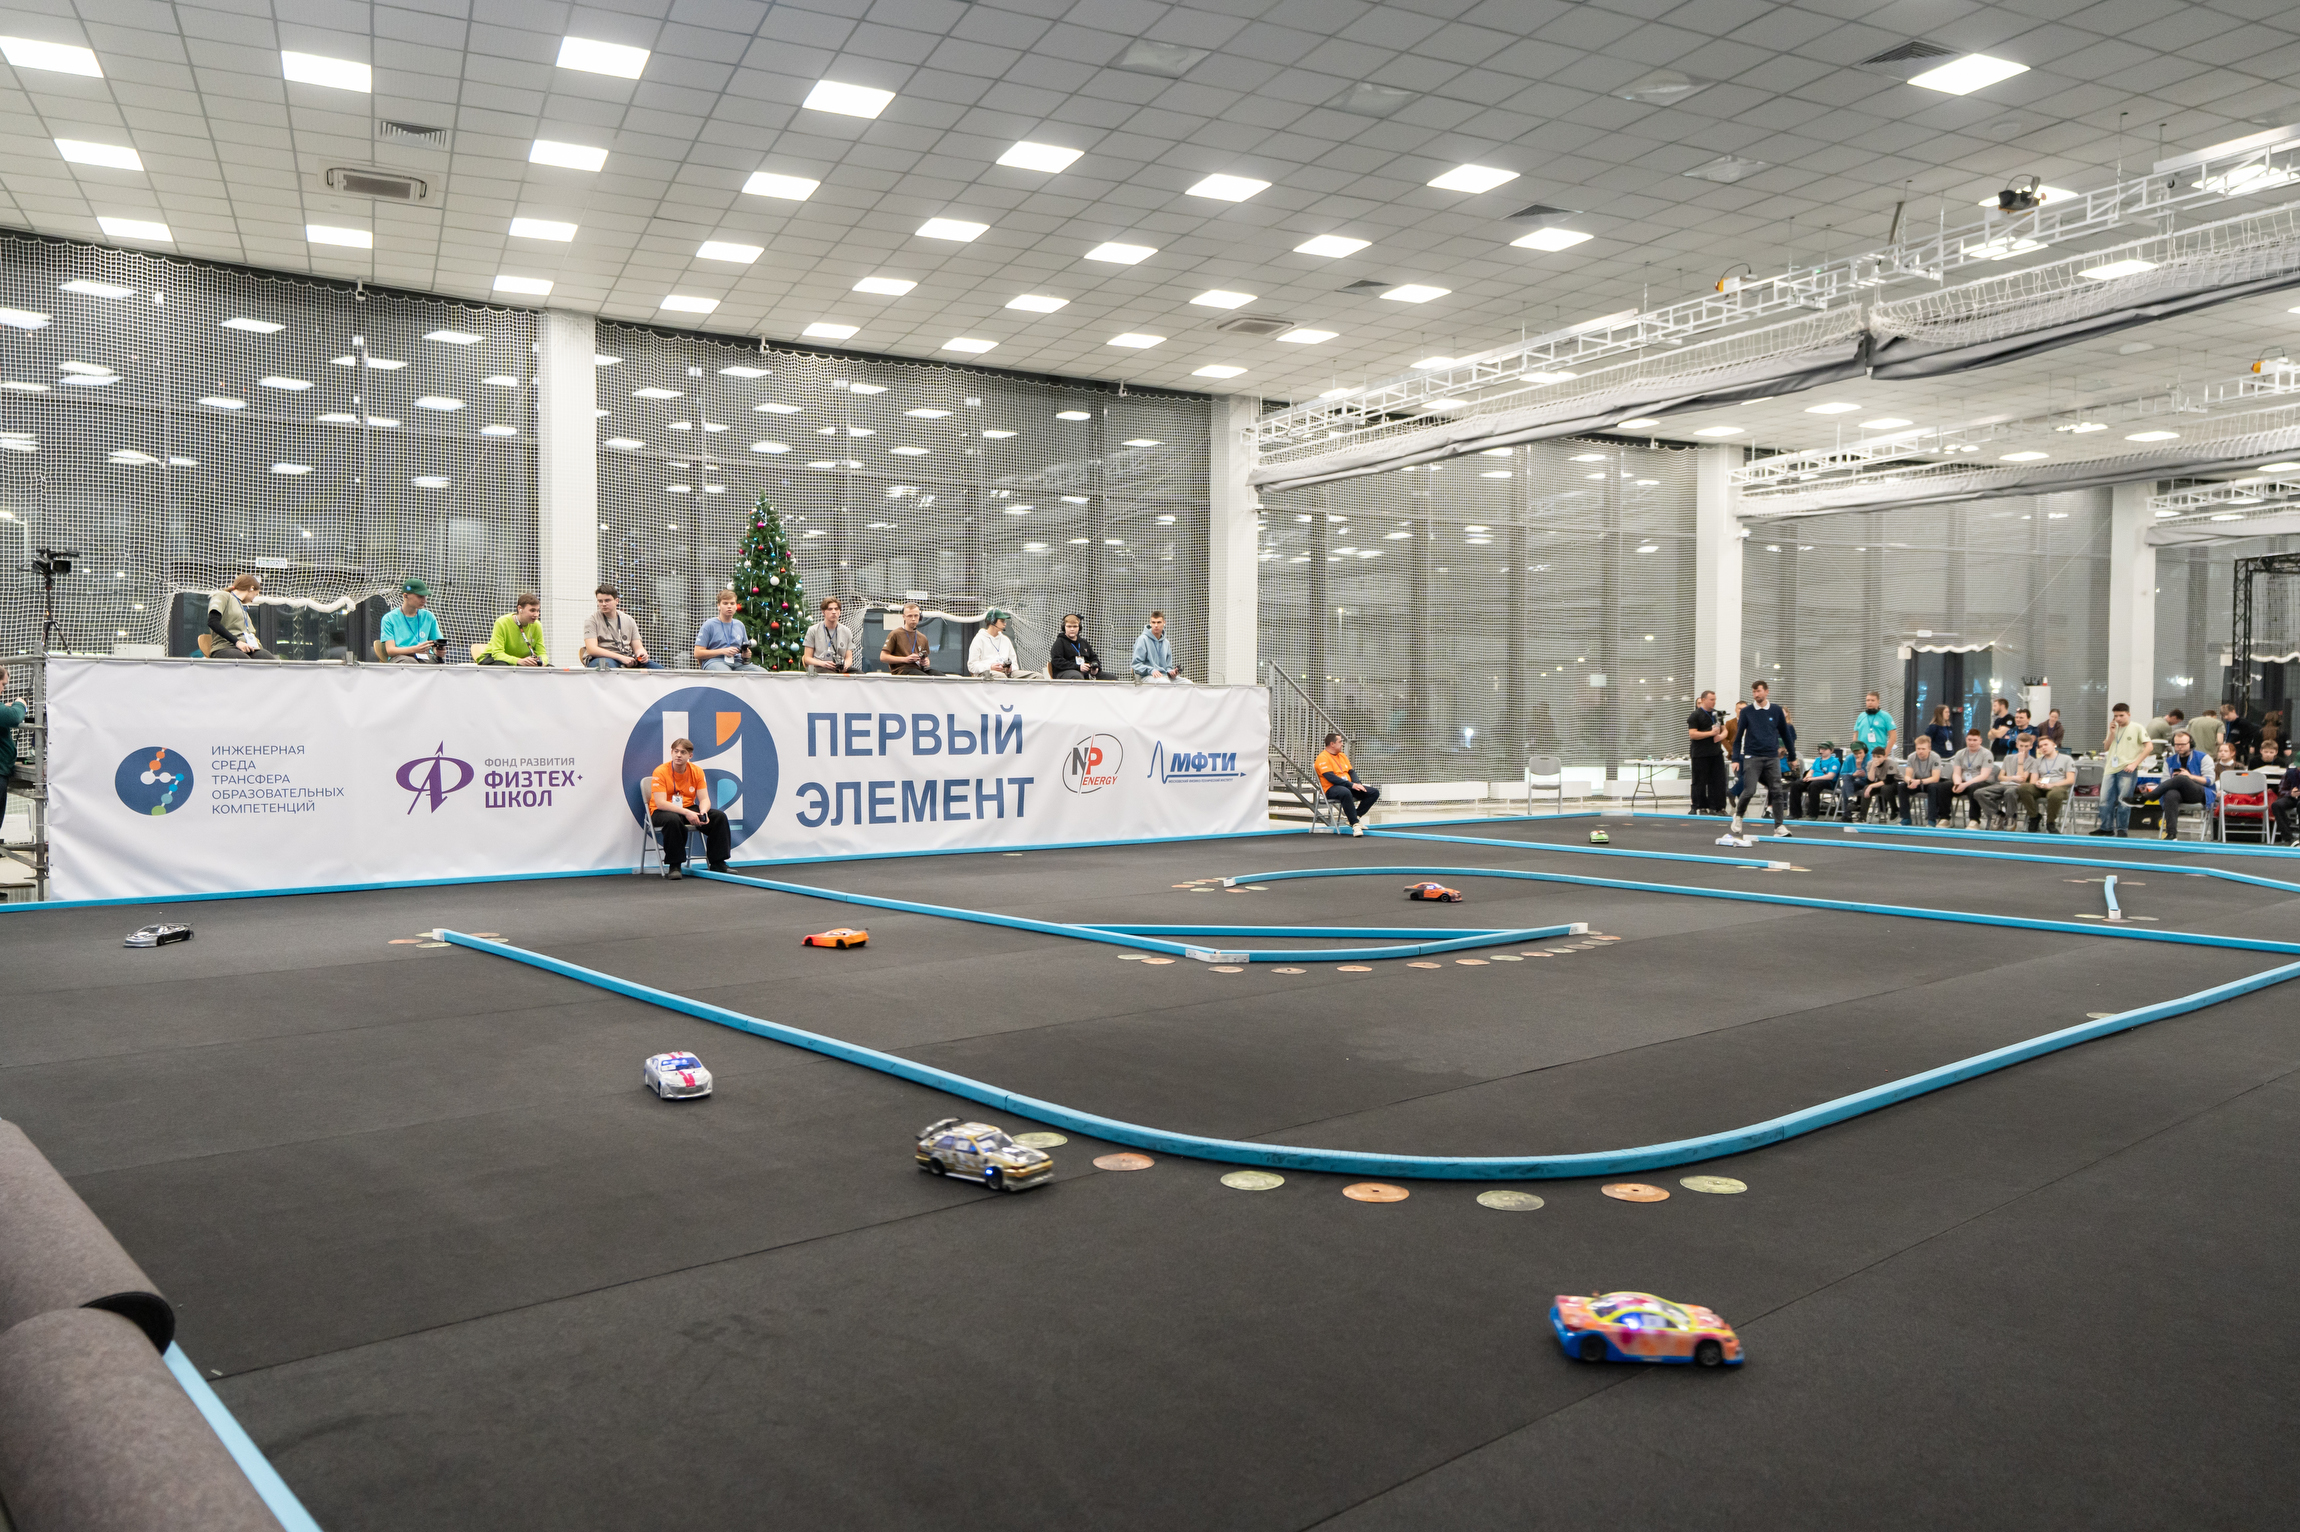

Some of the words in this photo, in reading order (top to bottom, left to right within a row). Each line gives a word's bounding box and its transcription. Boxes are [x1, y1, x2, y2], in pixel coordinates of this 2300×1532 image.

[807, 704, 1023, 757] ПЕРВЫЙ
[211, 745, 305, 755] ИНЖЕНЕРНАЯ
[211, 760, 256, 772] СРЕДА
[484, 758, 518, 768] ФОНД
[520, 757, 575, 767] РАЗВИТИЯ
[1072, 747, 1103, 775] NP
[1170, 752, 1237, 772] МФТИ
[211, 774, 291, 785] ТРАНСФЕРА
[1082, 776, 1118, 786] ENERGY
[211, 787, 345, 800] ОБРАЗОВАТЕЛЬНЫХ
[485, 790, 552, 808] ШКОЛ
[212, 800, 315, 814] КОМПЕТЕНЦИЙ
[795, 777, 1035, 828] ЭЛЕМЕНТ
